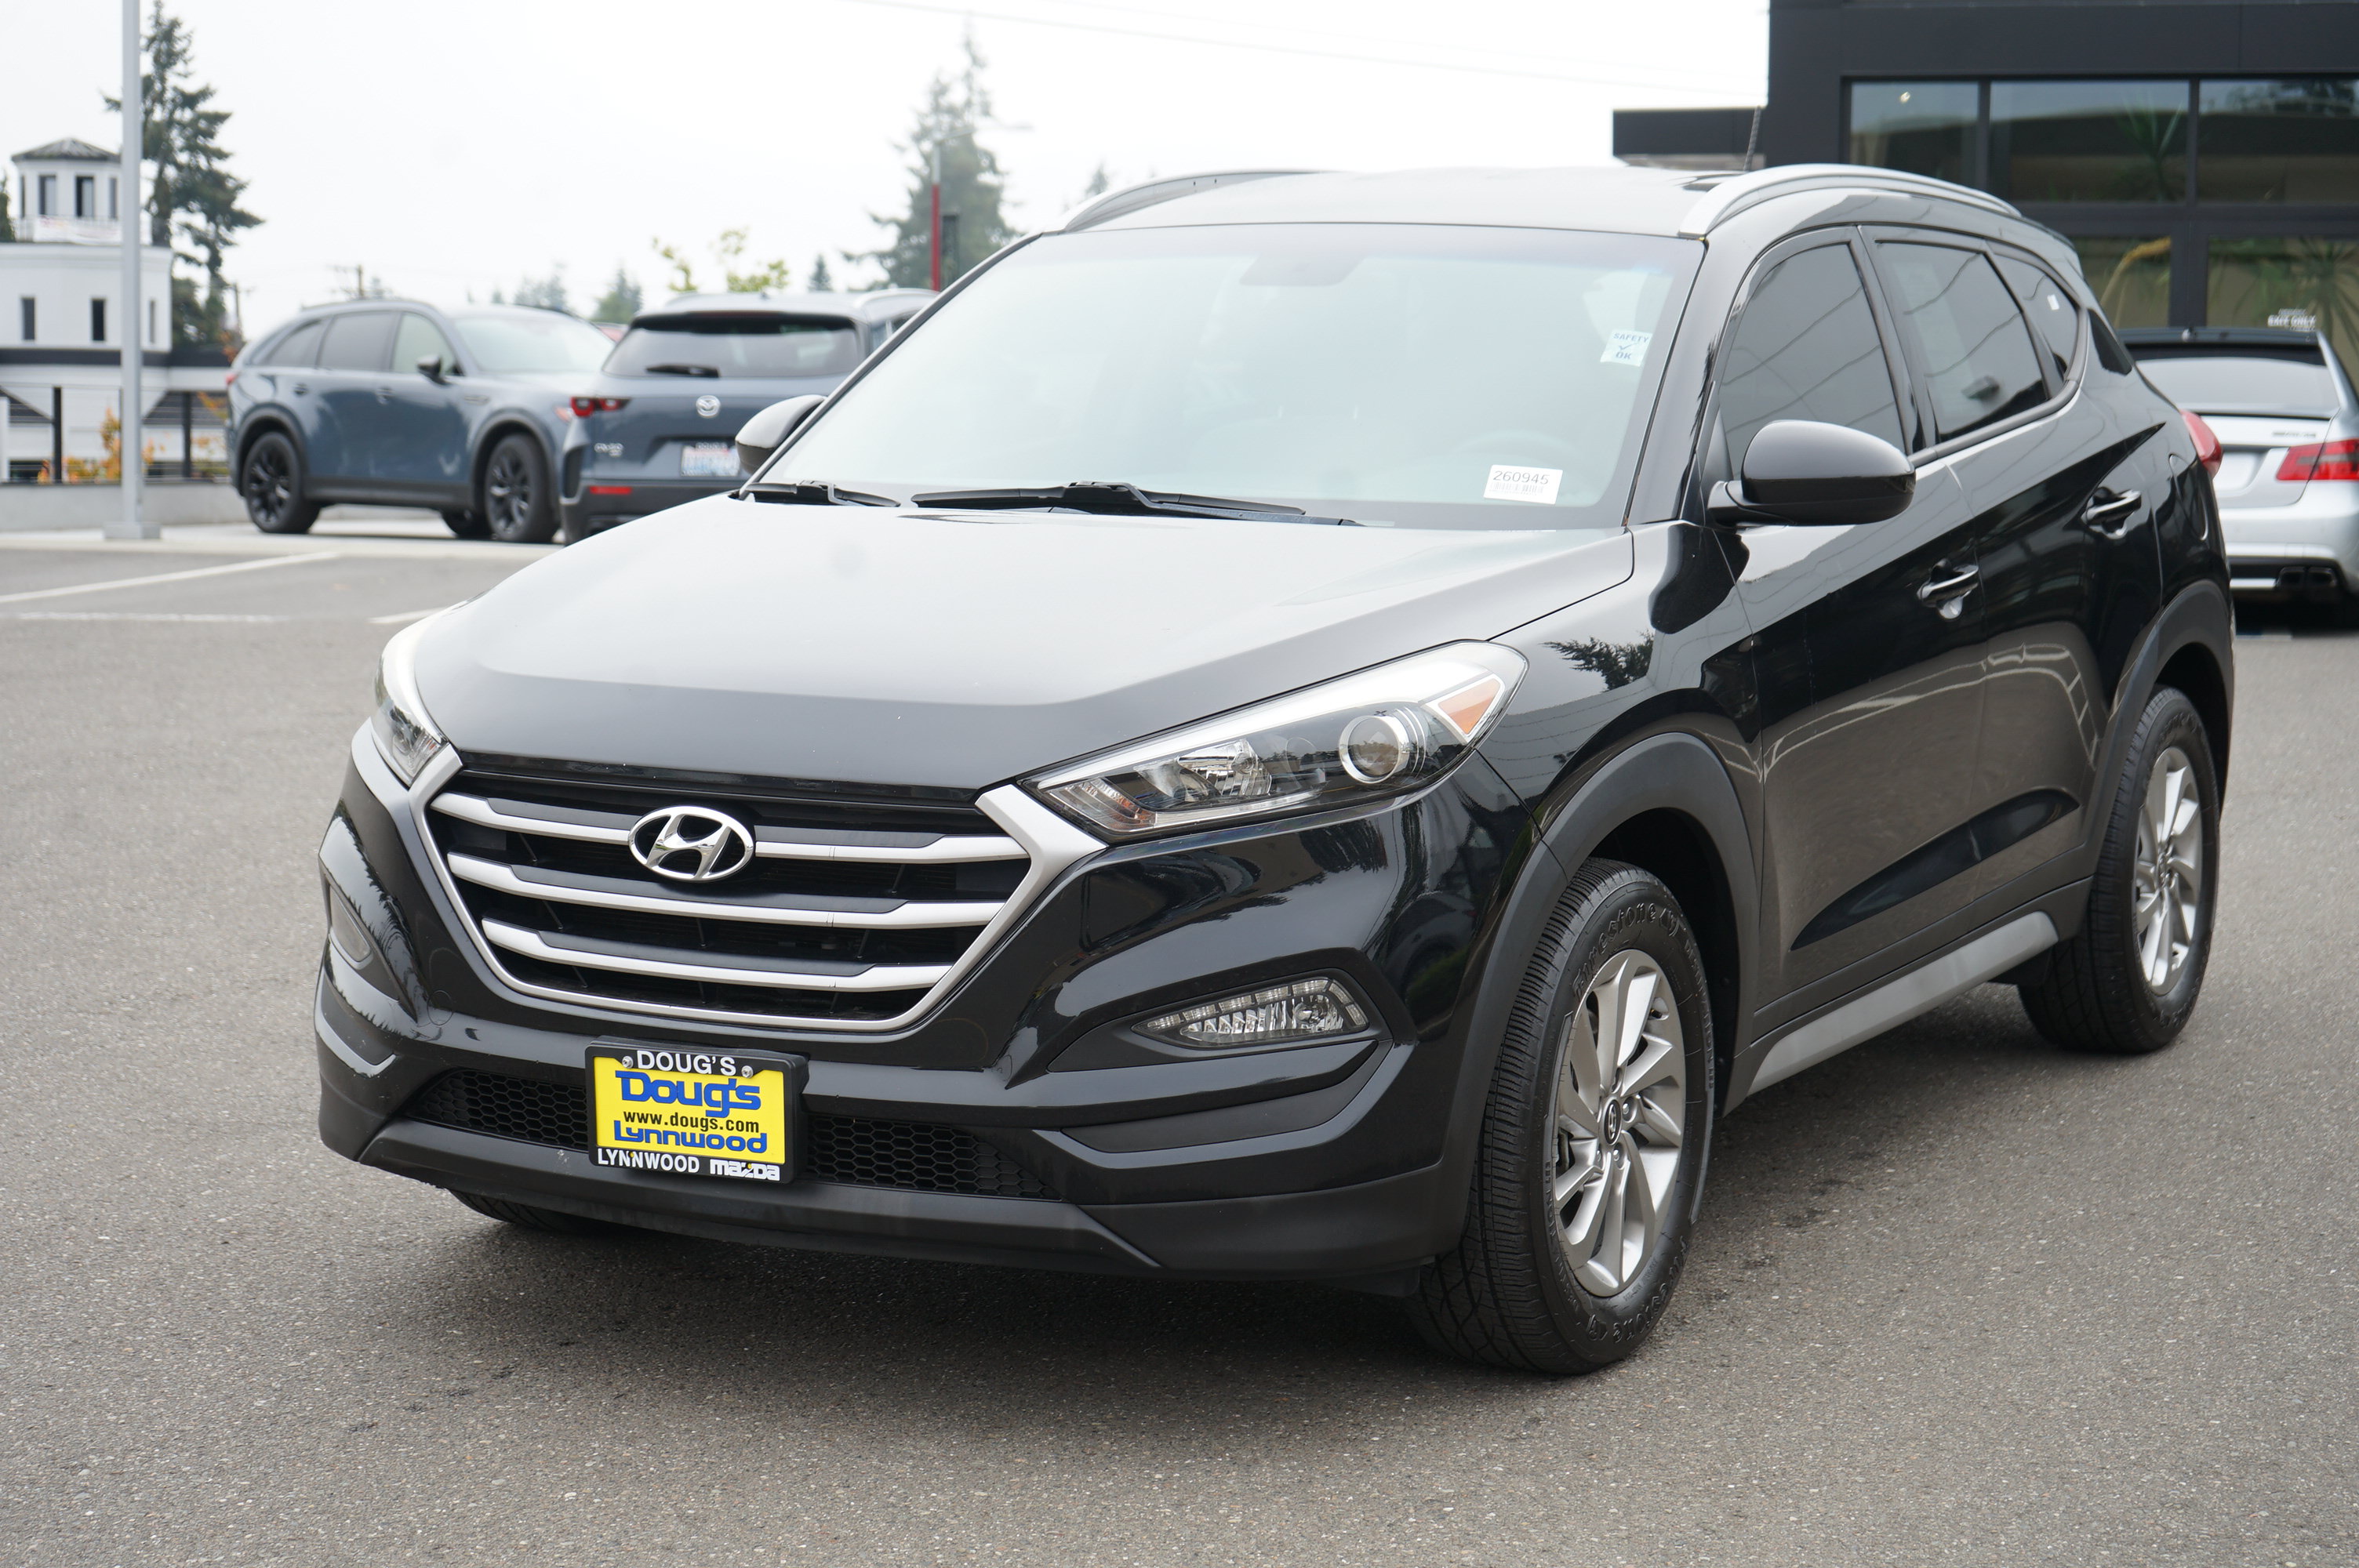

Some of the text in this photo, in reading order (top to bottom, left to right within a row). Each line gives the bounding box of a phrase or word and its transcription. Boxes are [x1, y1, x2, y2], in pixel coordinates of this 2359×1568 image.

[1613, 332, 1649, 343] SAFETY
[1616, 351, 1632, 360] OK
[1492, 470, 1550, 485] 260945
[637, 1050, 736, 1076] DOUG'S
[623, 1111, 759, 1133] www.dougs.com
[613, 1120, 767, 1153] Lynnwood
[598, 1148, 700, 1173] LYNNWOOD
